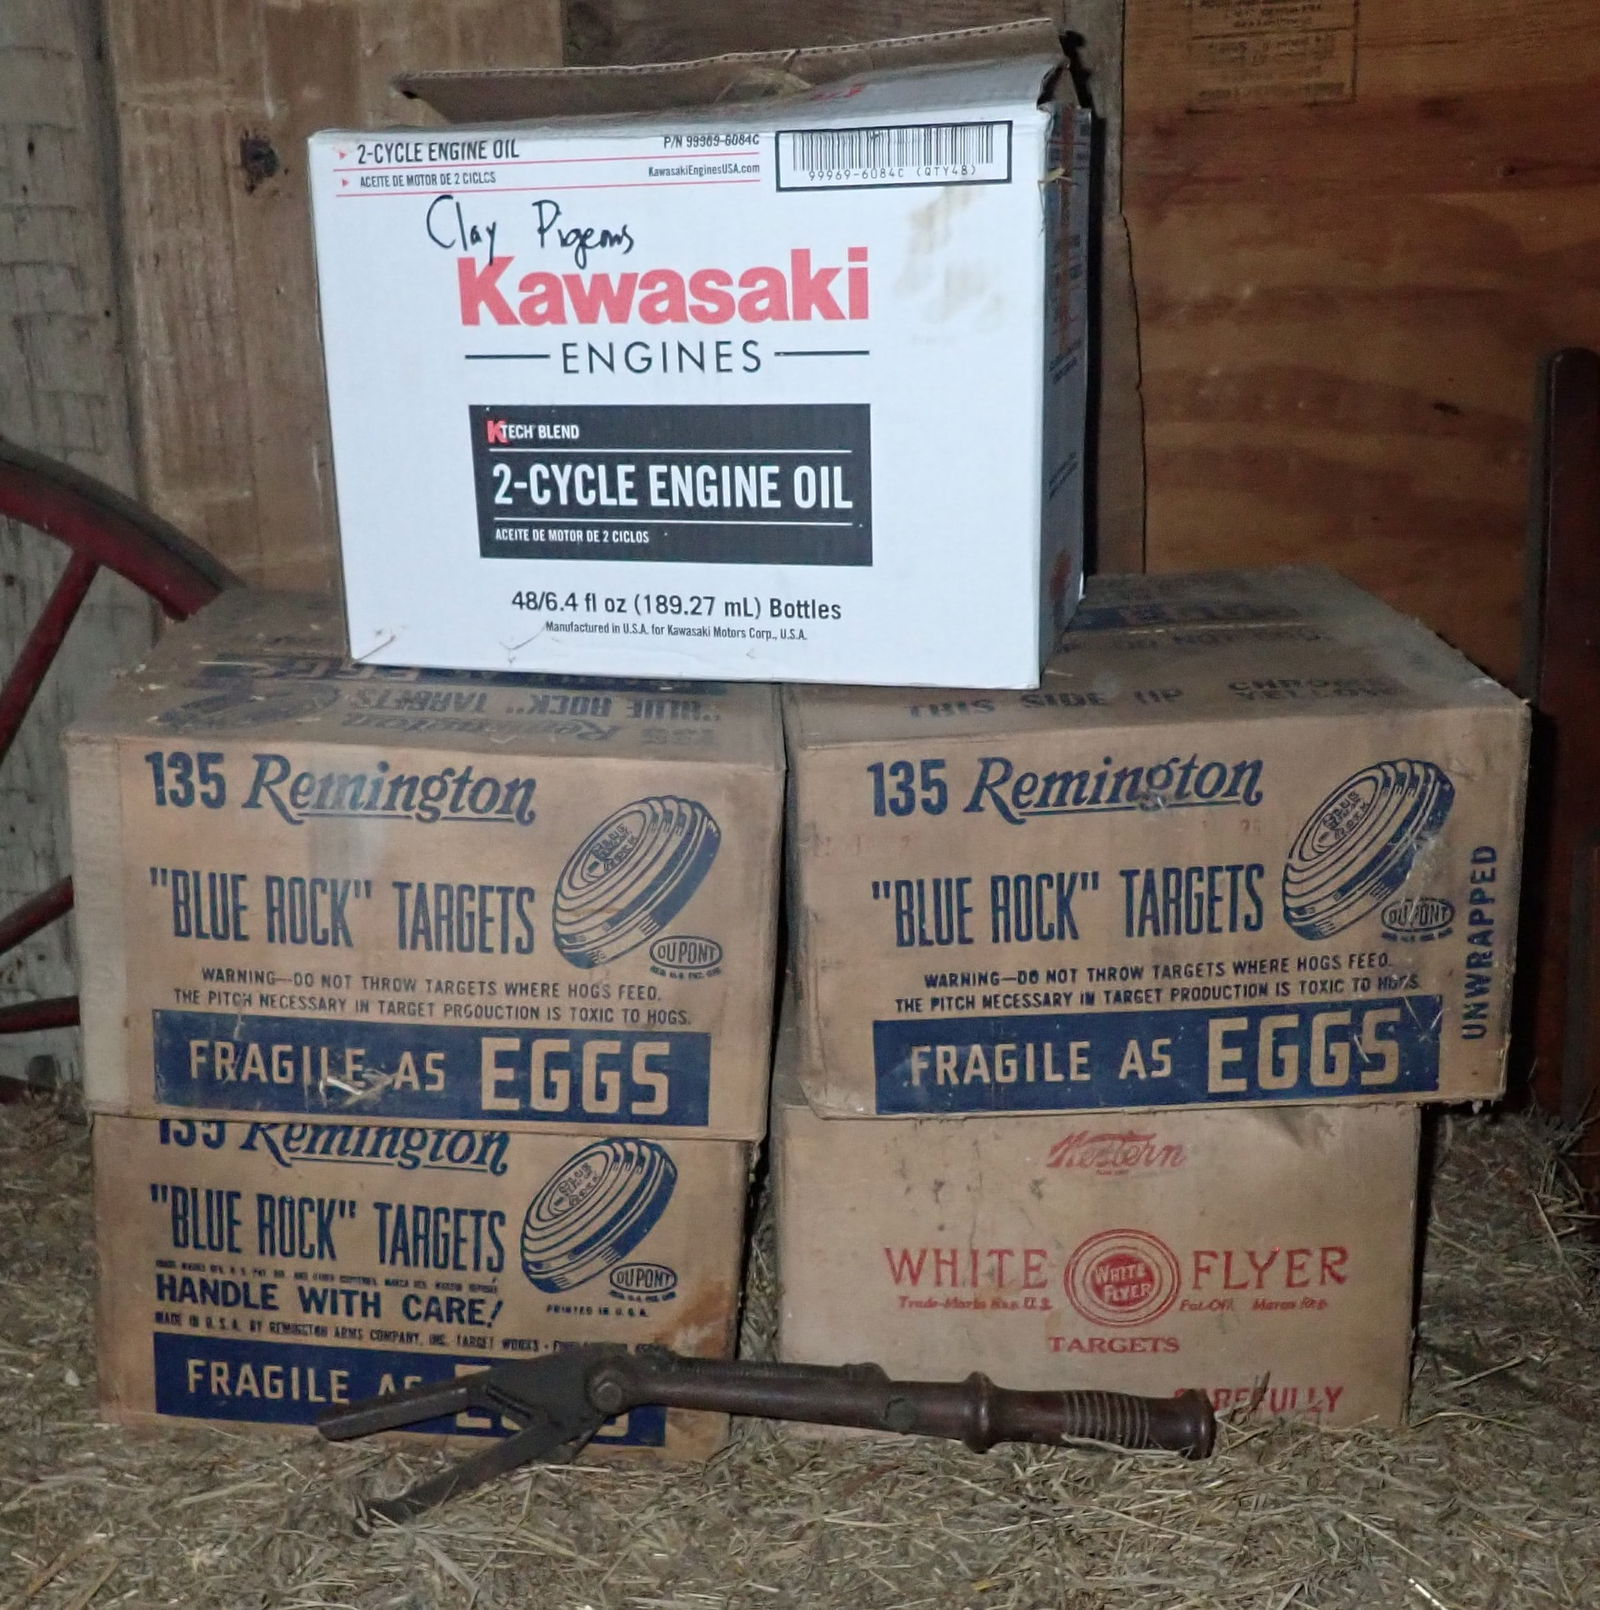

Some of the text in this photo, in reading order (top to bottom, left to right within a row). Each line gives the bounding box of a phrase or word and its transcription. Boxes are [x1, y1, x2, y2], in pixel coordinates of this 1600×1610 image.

[358, 139, 520, 165] 2-CYCLE ENGINE OIL
[663, 133, 760, 148] P/N 99969-6084C
[360, 175, 391, 188] ACEITE
[392, 174, 404, 187] DE
[407, 173, 438, 187] MOTOR
[440, 173, 451, 185] DE
[454, 172, 461, 185] 2
[648, 162, 760, 177] KawasakiEnginesUSA.com
[808, 164, 977, 182] 99969-6084C (QTY48)
[426, 194, 497, 265] Clay
[456, 246, 869, 328] Kawasaki
[562, 341, 761, 374] ENGINES
[538, 424, 579, 440] BLEND
[492, 462, 853, 509] 2-CYCLE ENGINE OIL
[495, 527, 649, 543] ACEITE DE MOTOR DE 2 CICLOS
[511, 590, 842, 620] 48/6.4 fl oz (189.27 mL) Bottles
[545, 621, 609, 634] Manufactured
[611, 623, 621, 634] in
[623, 623, 649, 635] U.S.A.
[651, 624, 665, 635] for
[667, 624, 711, 637] Kawasaki
[713, 626, 747, 638] Motors
[780, 628, 807, 641] U.S.A.
[902, 698, 996, 719] THIS
[1020, 691, 1107, 709] SIDE
[145, 751, 536, 826] 135 Remington
[867, 758, 948, 816] 135
[962, 754, 1264, 826] Remington
[149, 866, 536, 955] "BLUE ROCK" TARGETS
[871, 863, 1265, 948] "BLUE ROCK" TARGETS
[1462, 845, 1497, 1041] UNWRAPPED
[321, 974, 352, 990] NOT
[362, 976, 415, 993] THROW
[425, 979, 497, 997] TARGETS
[504, 981, 560, 998] WHERE
[568, 983, 612, 999] HOGS
[618, 985, 662, 1001] FEED.
[1046, 967, 1078, 984] NOT
[1087, 965, 1144, 983] THROW
[1152, 962, 1225, 979] TARGETS
[1232, 957, 1289, 975] WHERE
[1297, 954, 1342, 971] HOGS
[174, 988, 200, 1005] THE
[208, 989, 252, 1006] PITCH
[259, 993, 347, 1012] NECESSARY
[355, 1000, 369, 1013] IN
[378, 1000, 435, 1018] TARGET
[547, 1007, 561, 1020] IS
[571, 1007, 614, 1023] TOXIC
[622, 1008, 641, 1023] TO
[647, 1009, 692, 1025] HOGS.
[896, 998, 923, 1014] THE
[930, 996, 975, 1012] PITCH
[982, 992, 1072, 1010] NECESSARY
[1080, 991, 1095, 1006] IN
[1104, 988, 1162, 1005] TARGET
[1170, 983, 1268, 1001] PRODUCTION
[1275, 981, 1291, 996] IS
[1300, 979, 1345, 994] TOXIC
[1353, 977, 1371, 993] TO
[910, 1007, 1401, 1094] FRAGILE AS EGGS
[189, 1037, 671, 1116] FRAGILE AS EGGS
[240, 1123, 511, 1177] Remington
[150, 1183, 506, 1273] "BLUE ROCK" TARGETS
[885, 1245, 1350, 1290] WHITE FLYER
[155, 1274, 280, 1311] HANDLE
[298, 1285, 381, 1318] WITH
[402, 1294, 504, 1329] CARE!
[250, 1320, 262, 1332] BY
[334, 1325, 363, 1340] ARMS
[1049, 1336, 1181, 1355] TARGETS
[187, 1358, 350, 1405] FRAGILE
